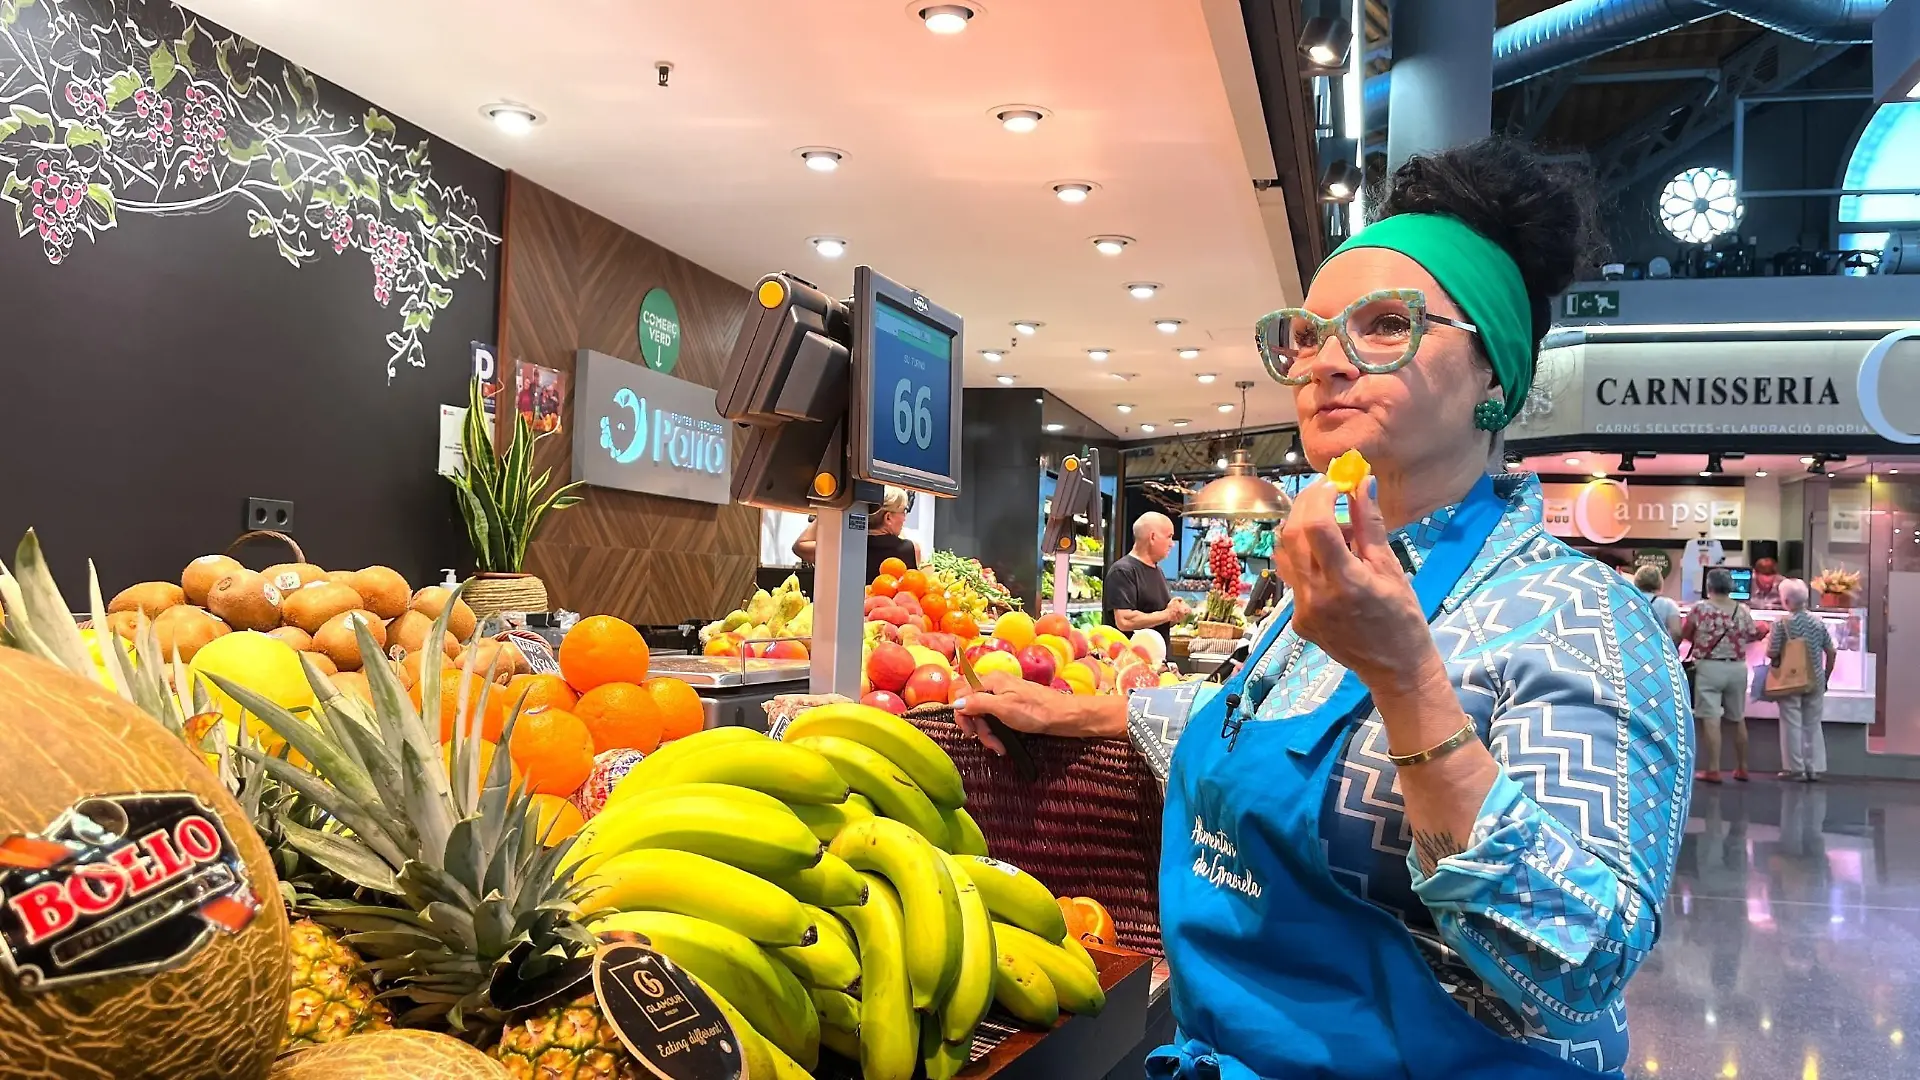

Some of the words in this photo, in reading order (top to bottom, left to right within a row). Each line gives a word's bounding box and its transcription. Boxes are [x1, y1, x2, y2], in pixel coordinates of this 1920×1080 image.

[643, 310, 677, 339] COMERÇ
[649, 326, 671, 347] VERD
[1595, 376, 1840, 406] CARNISSERIA
[893, 378, 932, 450] 66
[1596, 423, 1640, 434] CARNS
[1817, 423, 1870, 434] PROPIA
[1574, 477, 1710, 544] Camps
[8, 815, 222, 945] BOLLO
[1209, 853, 1262, 898] Graciela
[645, 994, 685, 1014] GLAMOUR
[656, 1037, 691, 1058] Eating
[688, 1020, 726, 1046] different!
